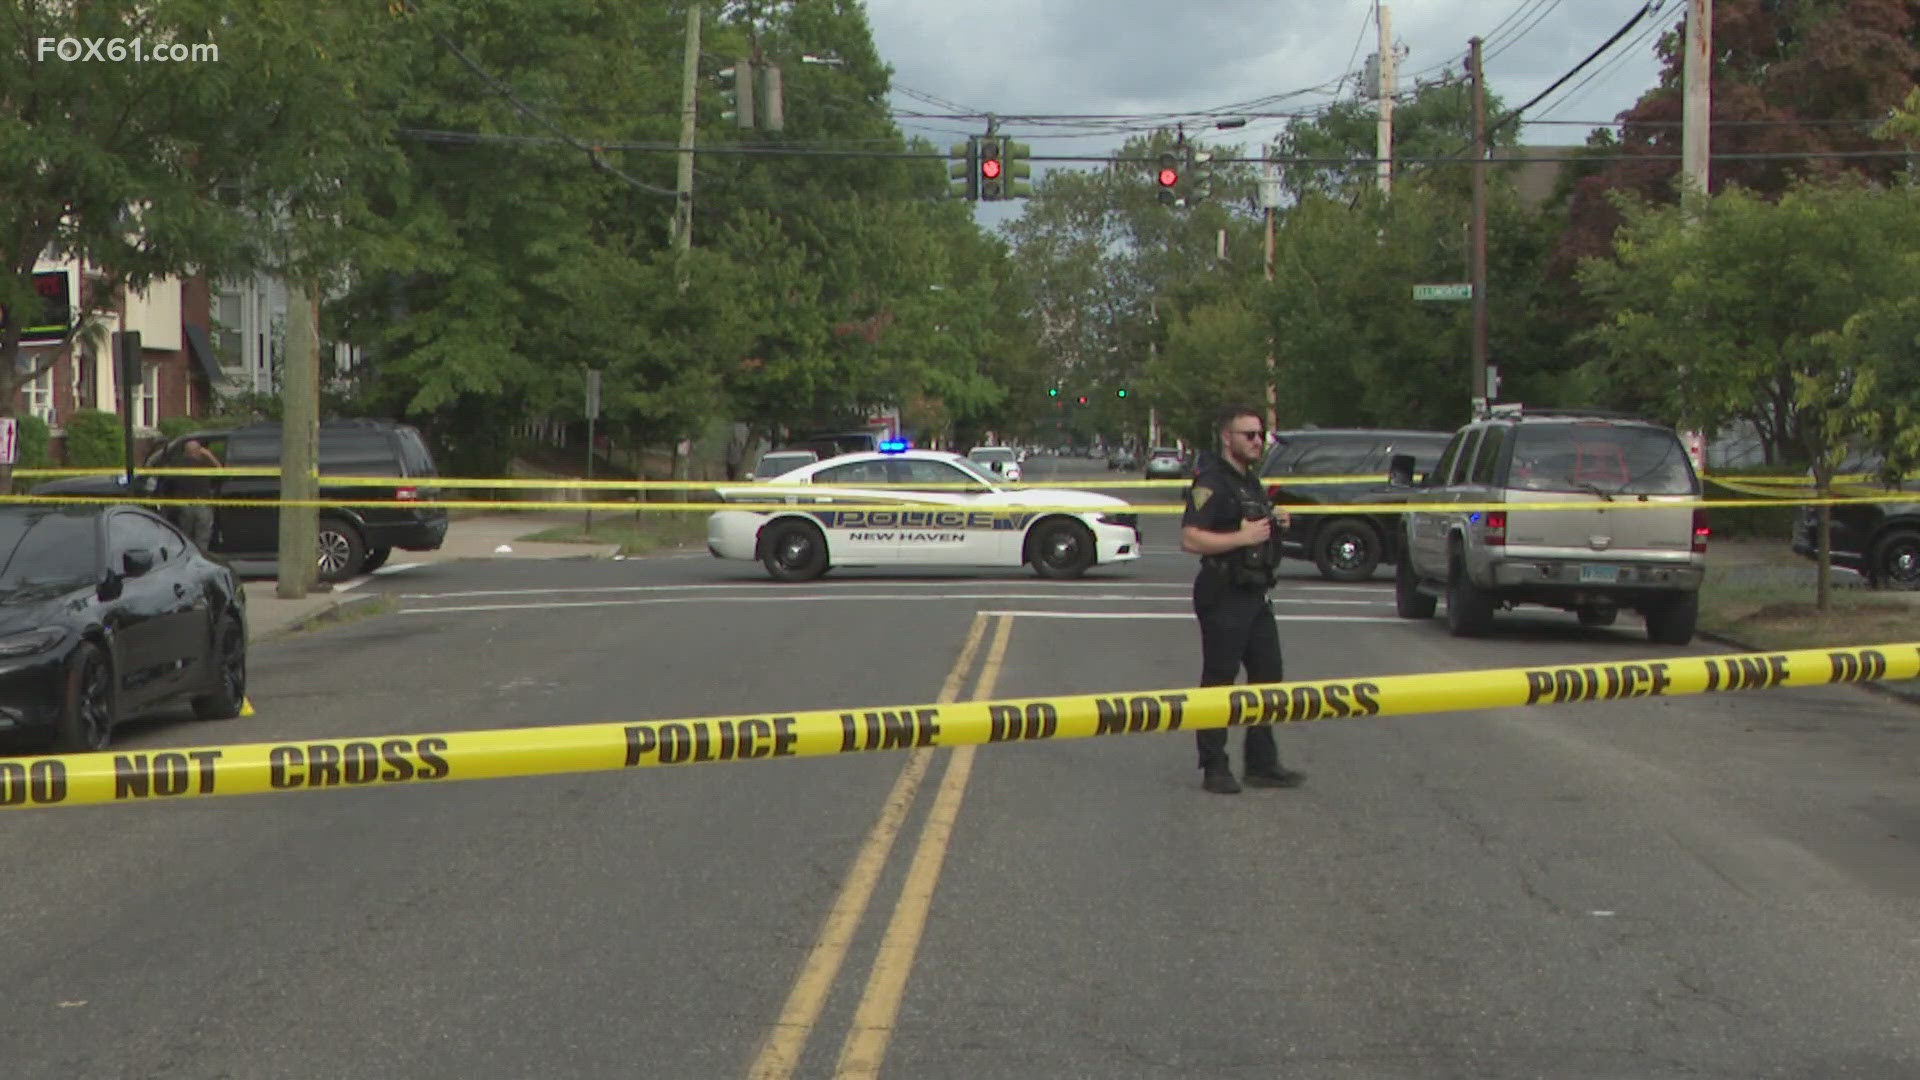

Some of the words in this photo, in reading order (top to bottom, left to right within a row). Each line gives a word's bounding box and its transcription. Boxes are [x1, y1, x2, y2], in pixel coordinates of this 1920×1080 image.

[833, 511, 995, 529] POLICE
[850, 533, 894, 541] NEW
[899, 533, 965, 542] HAVEN
[0, 759, 67, 805] DO
[113, 751, 223, 800] NOT
[269, 738, 449, 789] CROSS
[624, 717, 798, 767] POLICE
[839, 709, 940, 752] LINE
[989, 703, 1057, 742] DO
[1094, 694, 1188, 735] NOT
[1227, 682, 1380, 726] CROSS
[1525, 663, 1671, 705] POLICE
[1704, 655, 1790, 692] LINE
[1827, 650, 1886, 683] DO
